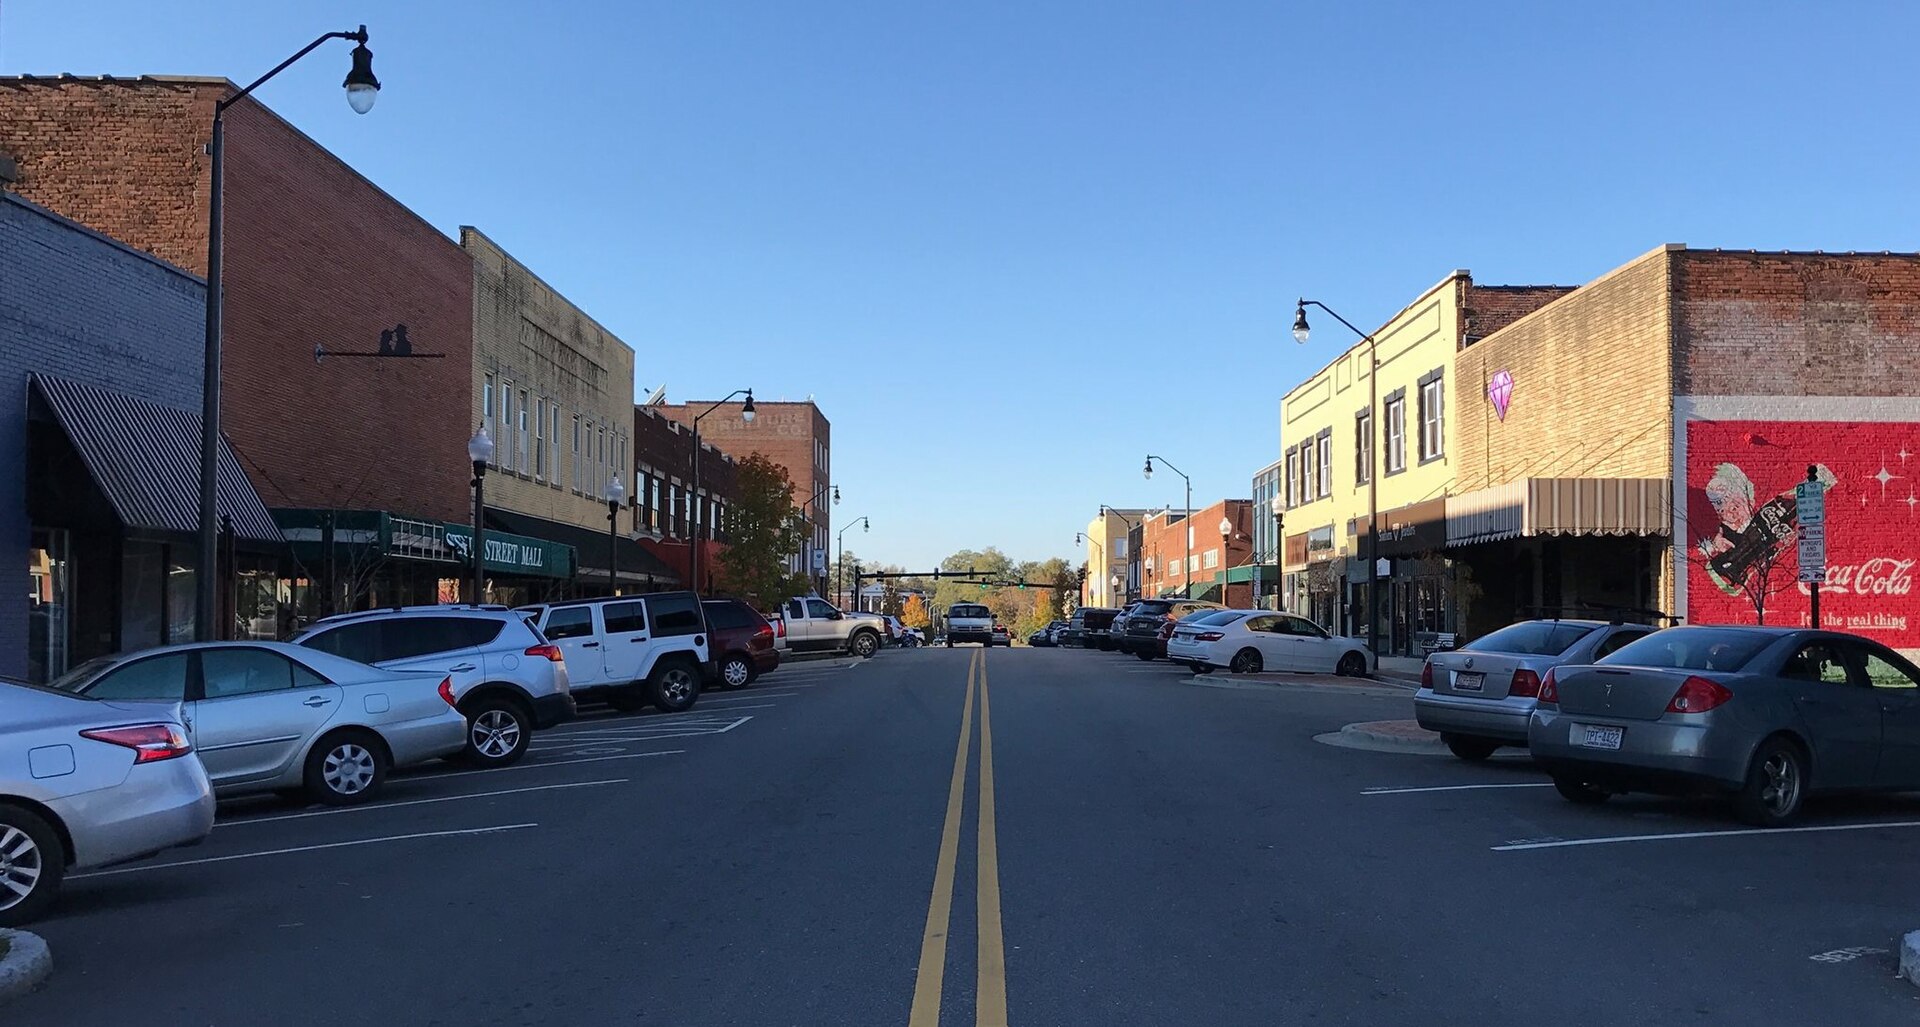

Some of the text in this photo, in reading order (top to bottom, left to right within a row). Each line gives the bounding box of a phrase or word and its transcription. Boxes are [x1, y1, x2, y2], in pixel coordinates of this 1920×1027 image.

[1798, 486, 1804, 496] 2
[484, 539, 518, 564] STREET
[520, 545, 543, 567] MALL
[1798, 557, 1917, 596] ca-Cola
[1824, 611, 1843, 626] the
[1847, 611, 1871, 626] real
[1873, 611, 1907, 630] thing
[1586, 730, 1620, 742] TPT-4422
